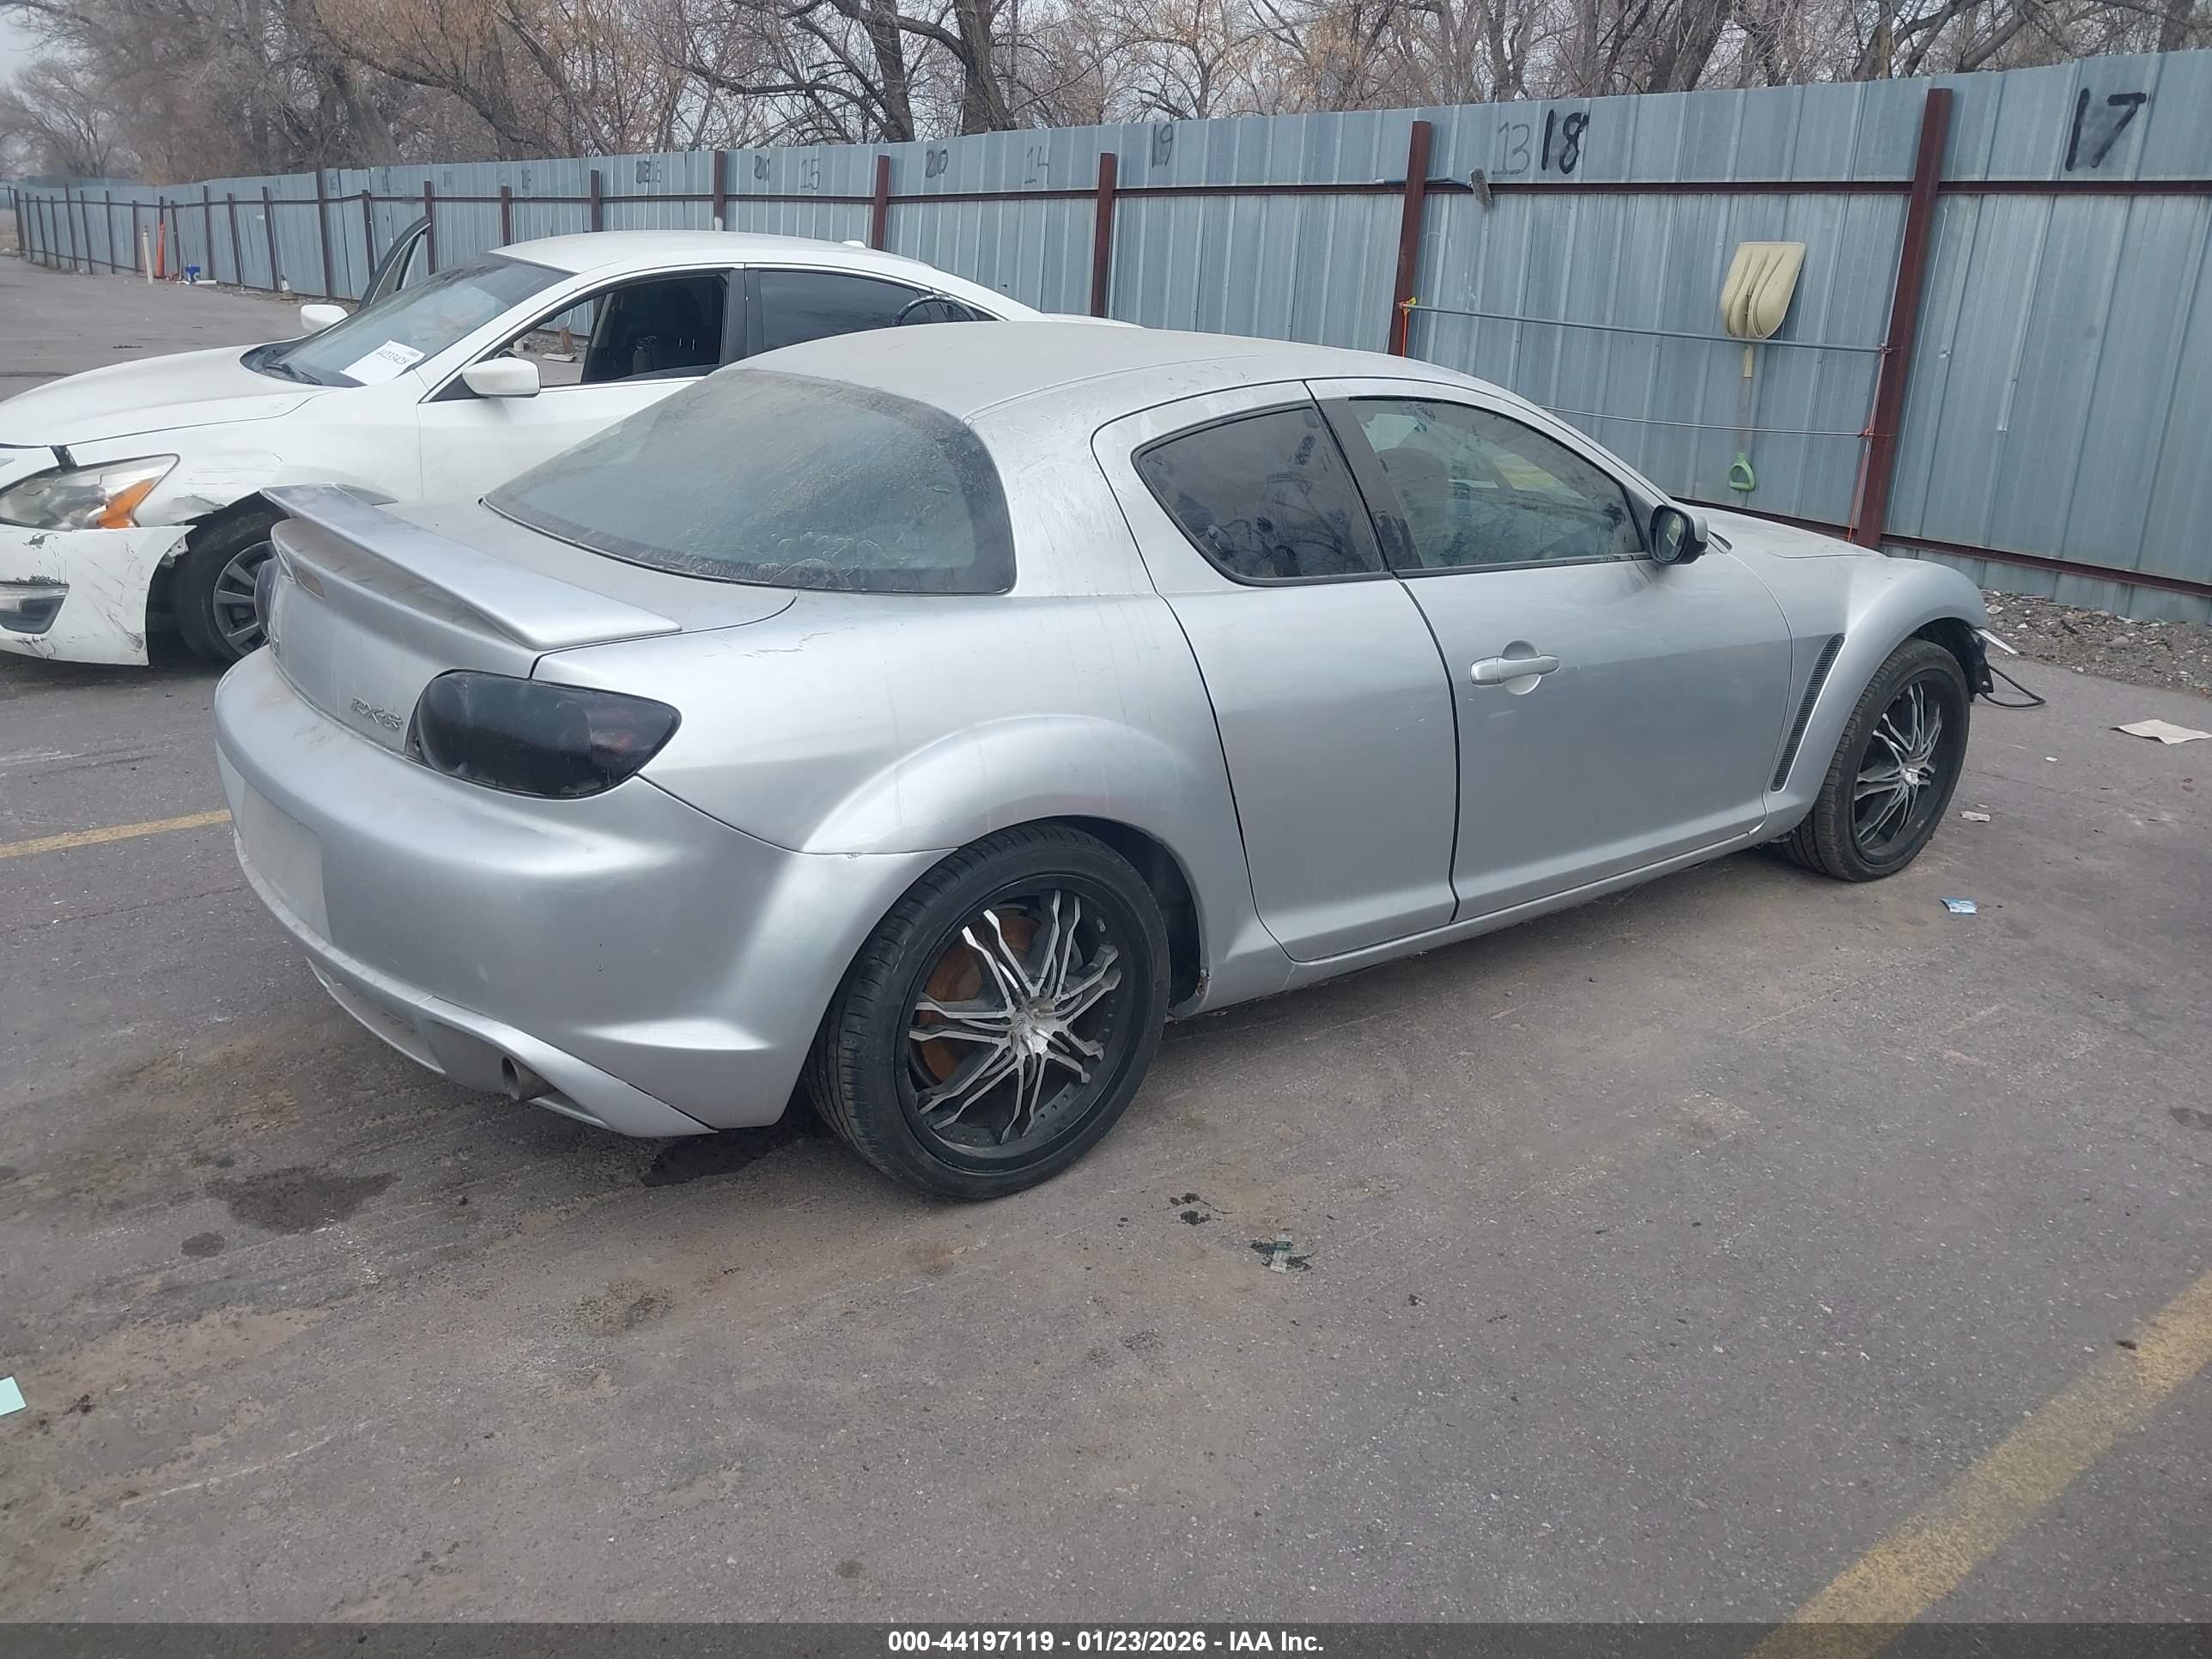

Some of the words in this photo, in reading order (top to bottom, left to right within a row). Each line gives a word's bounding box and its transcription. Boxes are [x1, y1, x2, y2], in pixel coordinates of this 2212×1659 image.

[1152, 123, 1174, 168] 19
[1492, 121, 1531, 175] 13
[1540, 108, 1590, 175] 18
[2063, 88, 2148, 172] 17
[799, 157, 821, 191] 15
[926, 149, 949, 179] 20
